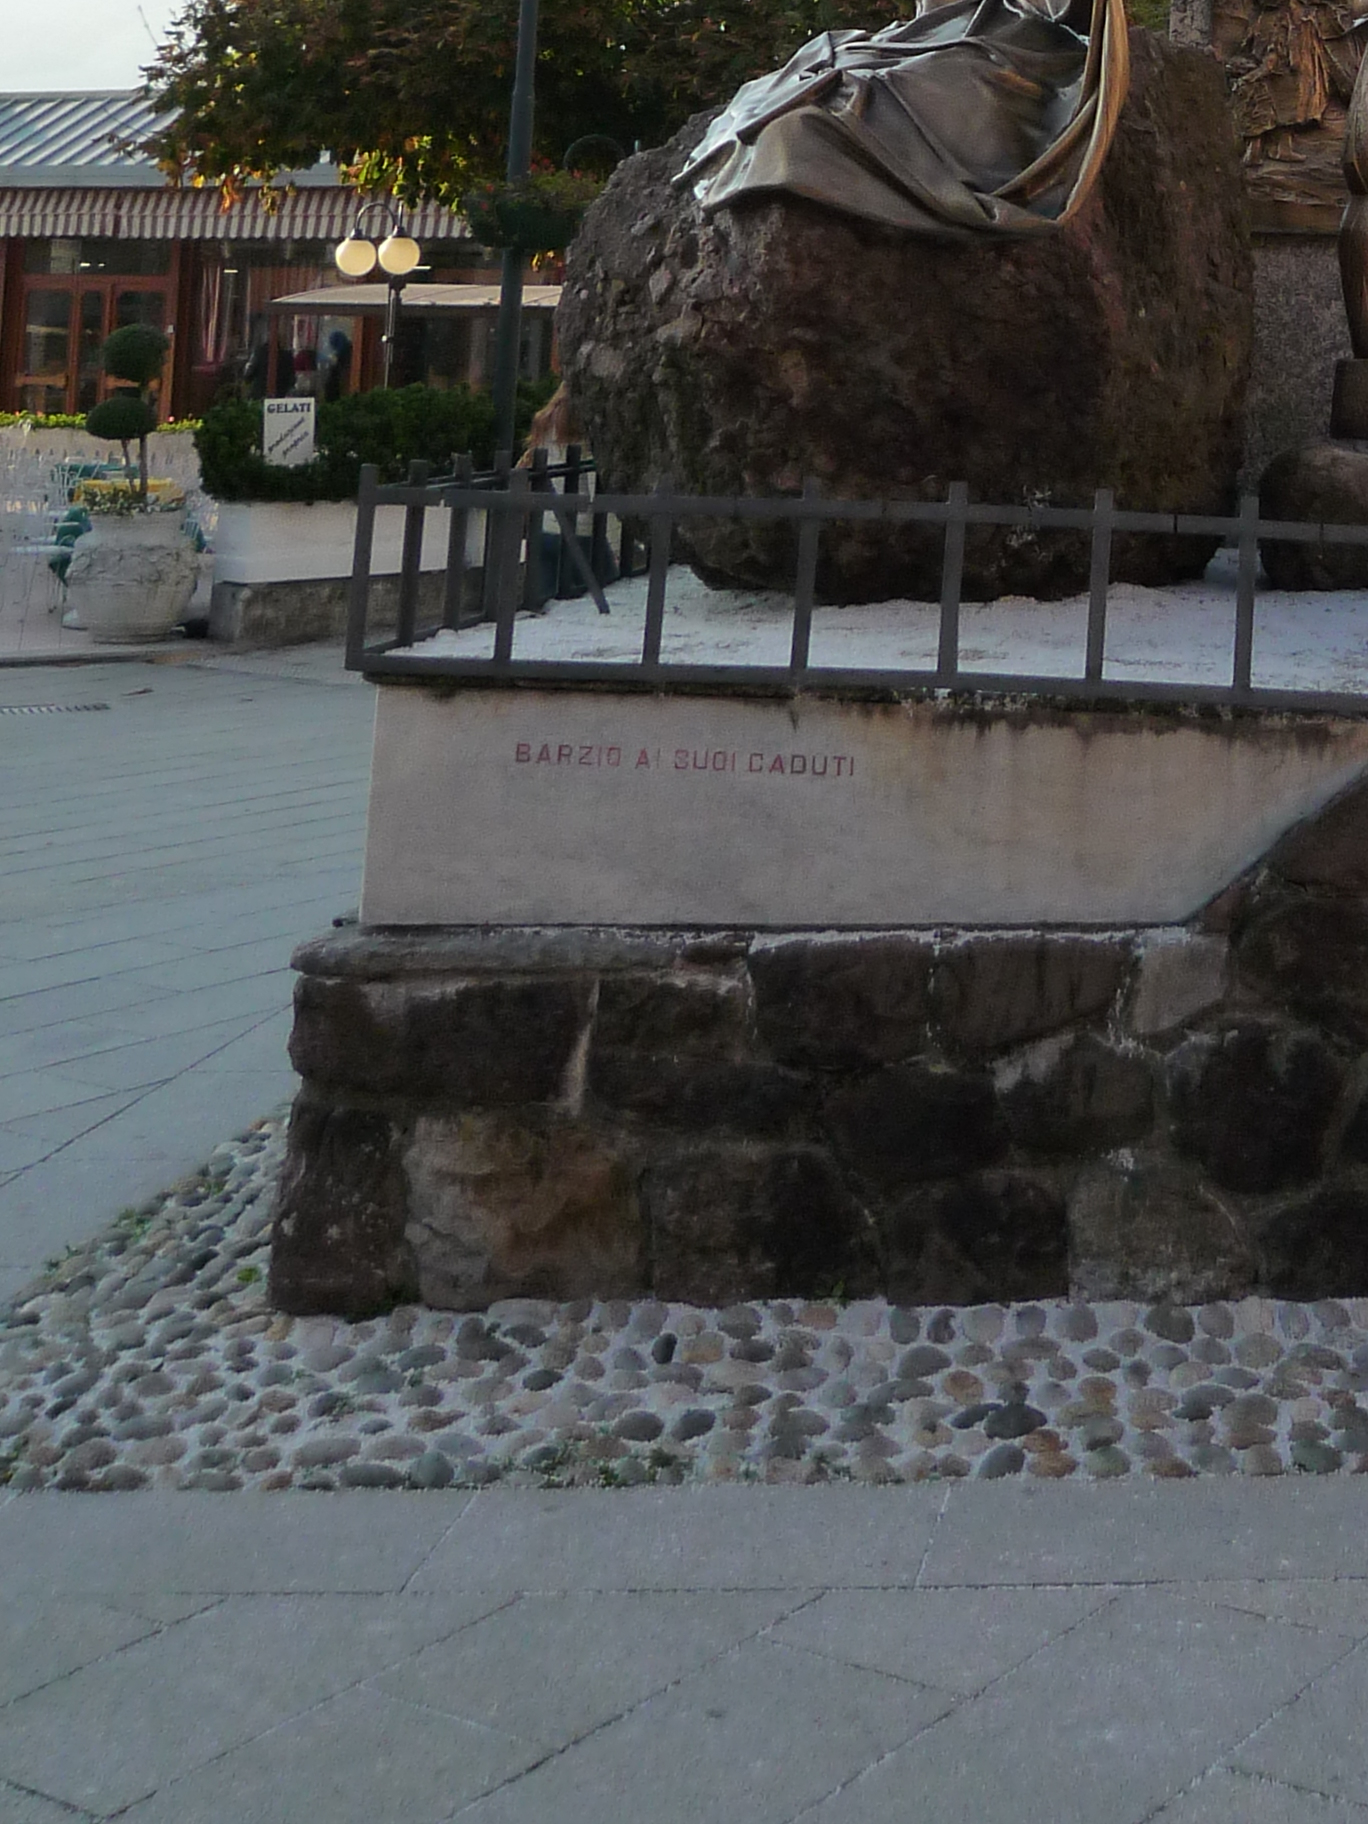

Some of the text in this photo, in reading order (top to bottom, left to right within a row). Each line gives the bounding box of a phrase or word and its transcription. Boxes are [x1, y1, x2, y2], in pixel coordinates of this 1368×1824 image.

[266, 402, 311, 414] GELATI
[515, 741, 855, 777] BARZIO AI SUOI CADUTI
